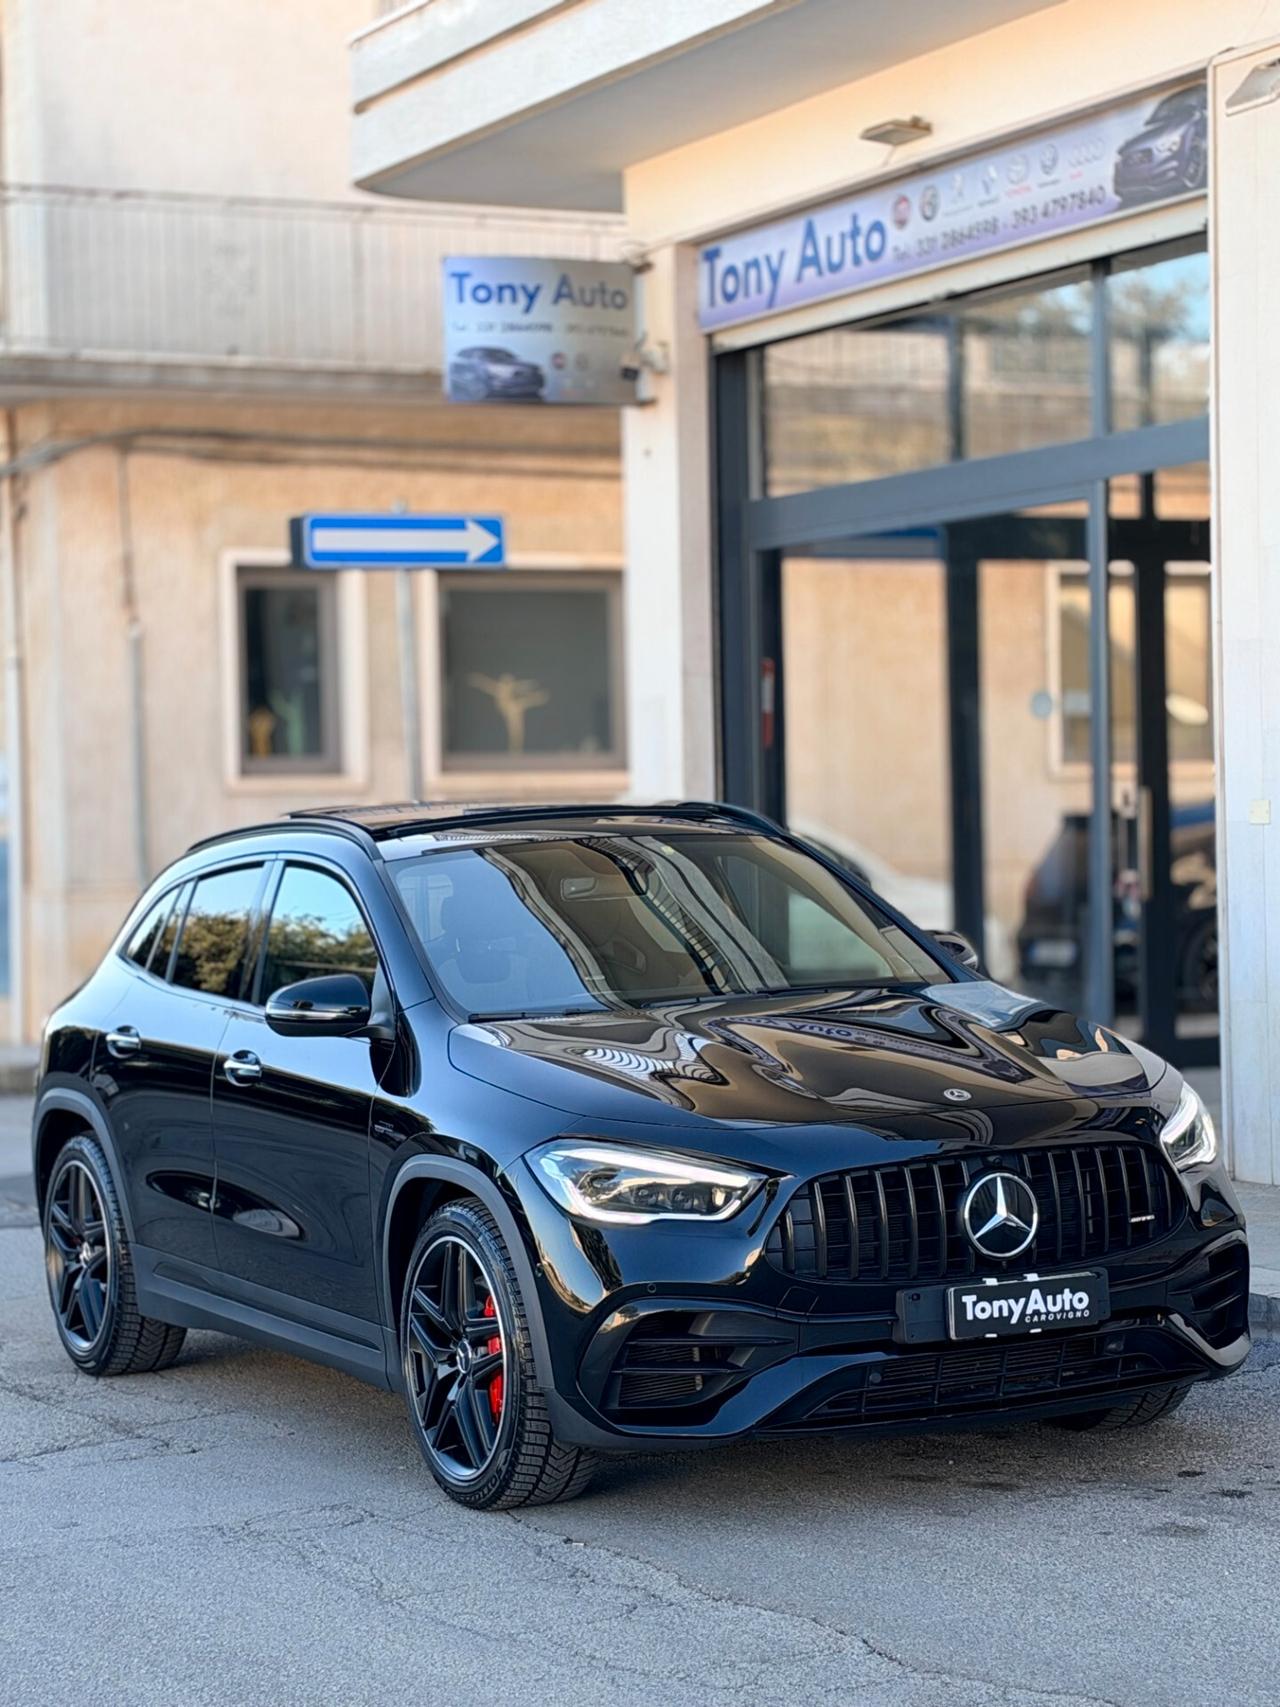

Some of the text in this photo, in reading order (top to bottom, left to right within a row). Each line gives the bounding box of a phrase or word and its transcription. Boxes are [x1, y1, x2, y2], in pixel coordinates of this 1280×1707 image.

[702, 213, 886, 309] Tony Auto
[450, 272, 629, 314] Tony Auto
[1024, 1309, 1091, 1323] CAROVIGNO
